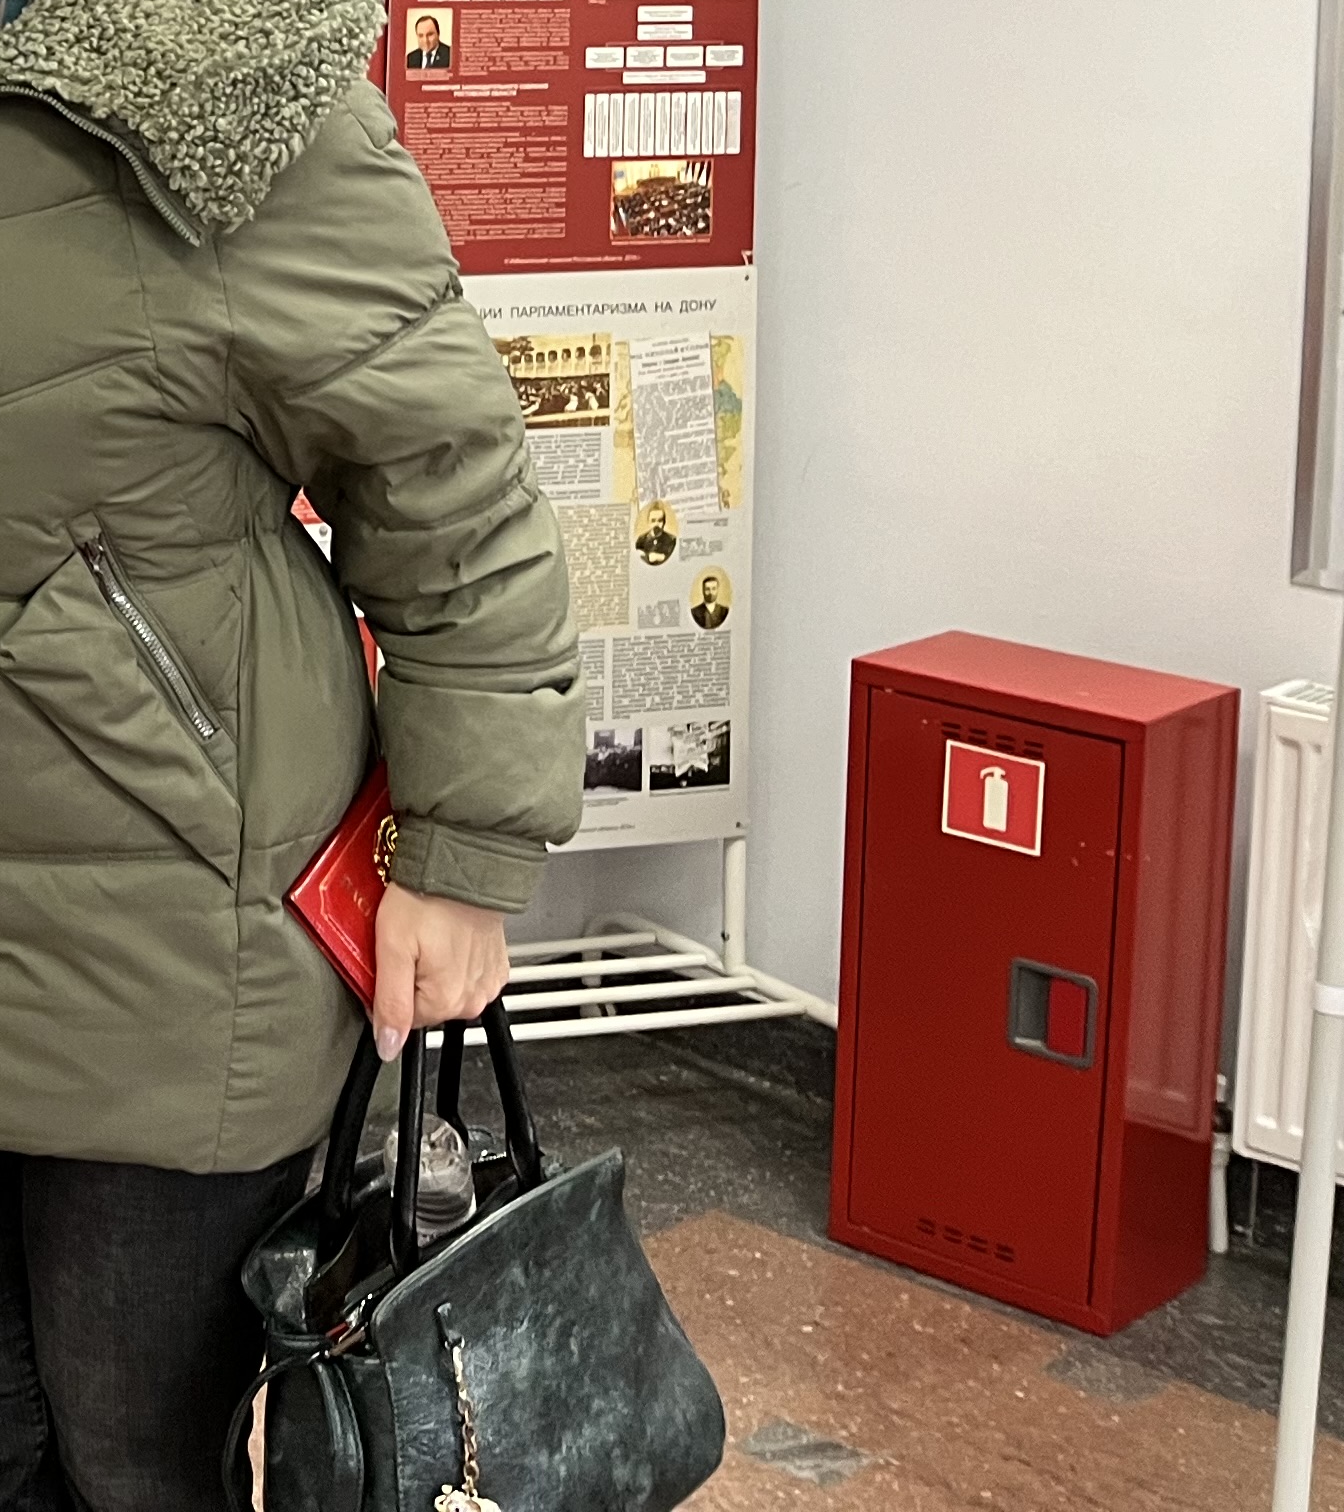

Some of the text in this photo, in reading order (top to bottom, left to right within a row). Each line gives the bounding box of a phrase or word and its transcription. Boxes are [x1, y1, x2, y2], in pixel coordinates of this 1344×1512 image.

[510, 301, 648, 320] ПАРЛАМЕНТАРИЗМА
[653, 300, 674, 314] НА
[678, 298, 717, 315] ДОНУ
